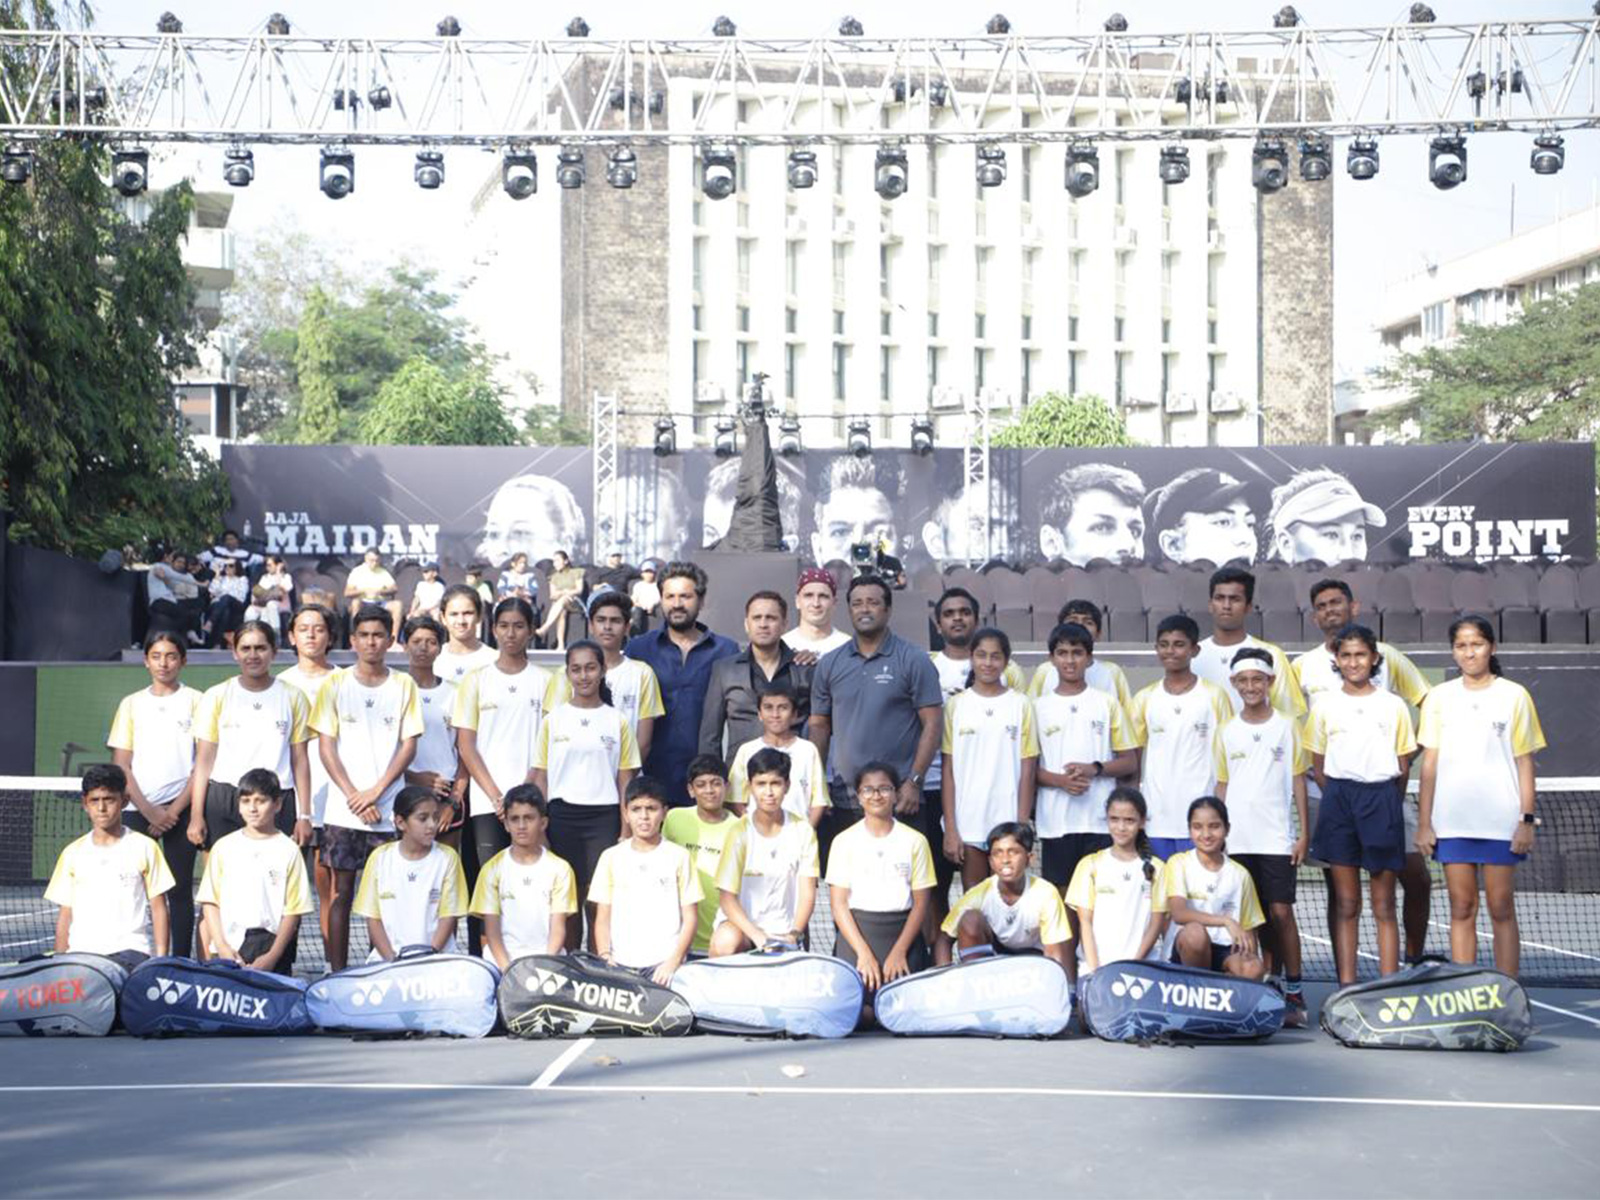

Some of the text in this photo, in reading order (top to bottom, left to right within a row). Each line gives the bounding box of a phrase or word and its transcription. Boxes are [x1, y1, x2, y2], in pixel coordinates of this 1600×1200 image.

[264, 512, 311, 524] AAJA
[1407, 506, 1475, 521] EVERY
[264, 524, 440, 554] MAIDAN
[1408, 519, 1569, 556] POINT
[16, 978, 86, 1010] YONEX
[195, 985, 269, 1019] YONEX
[397, 972, 474, 1001] YONEX
[571, 980, 643, 1016] YONEX
[1158, 981, 1234, 1013] YONEX
[1423, 984, 1506, 1017] YONEX
